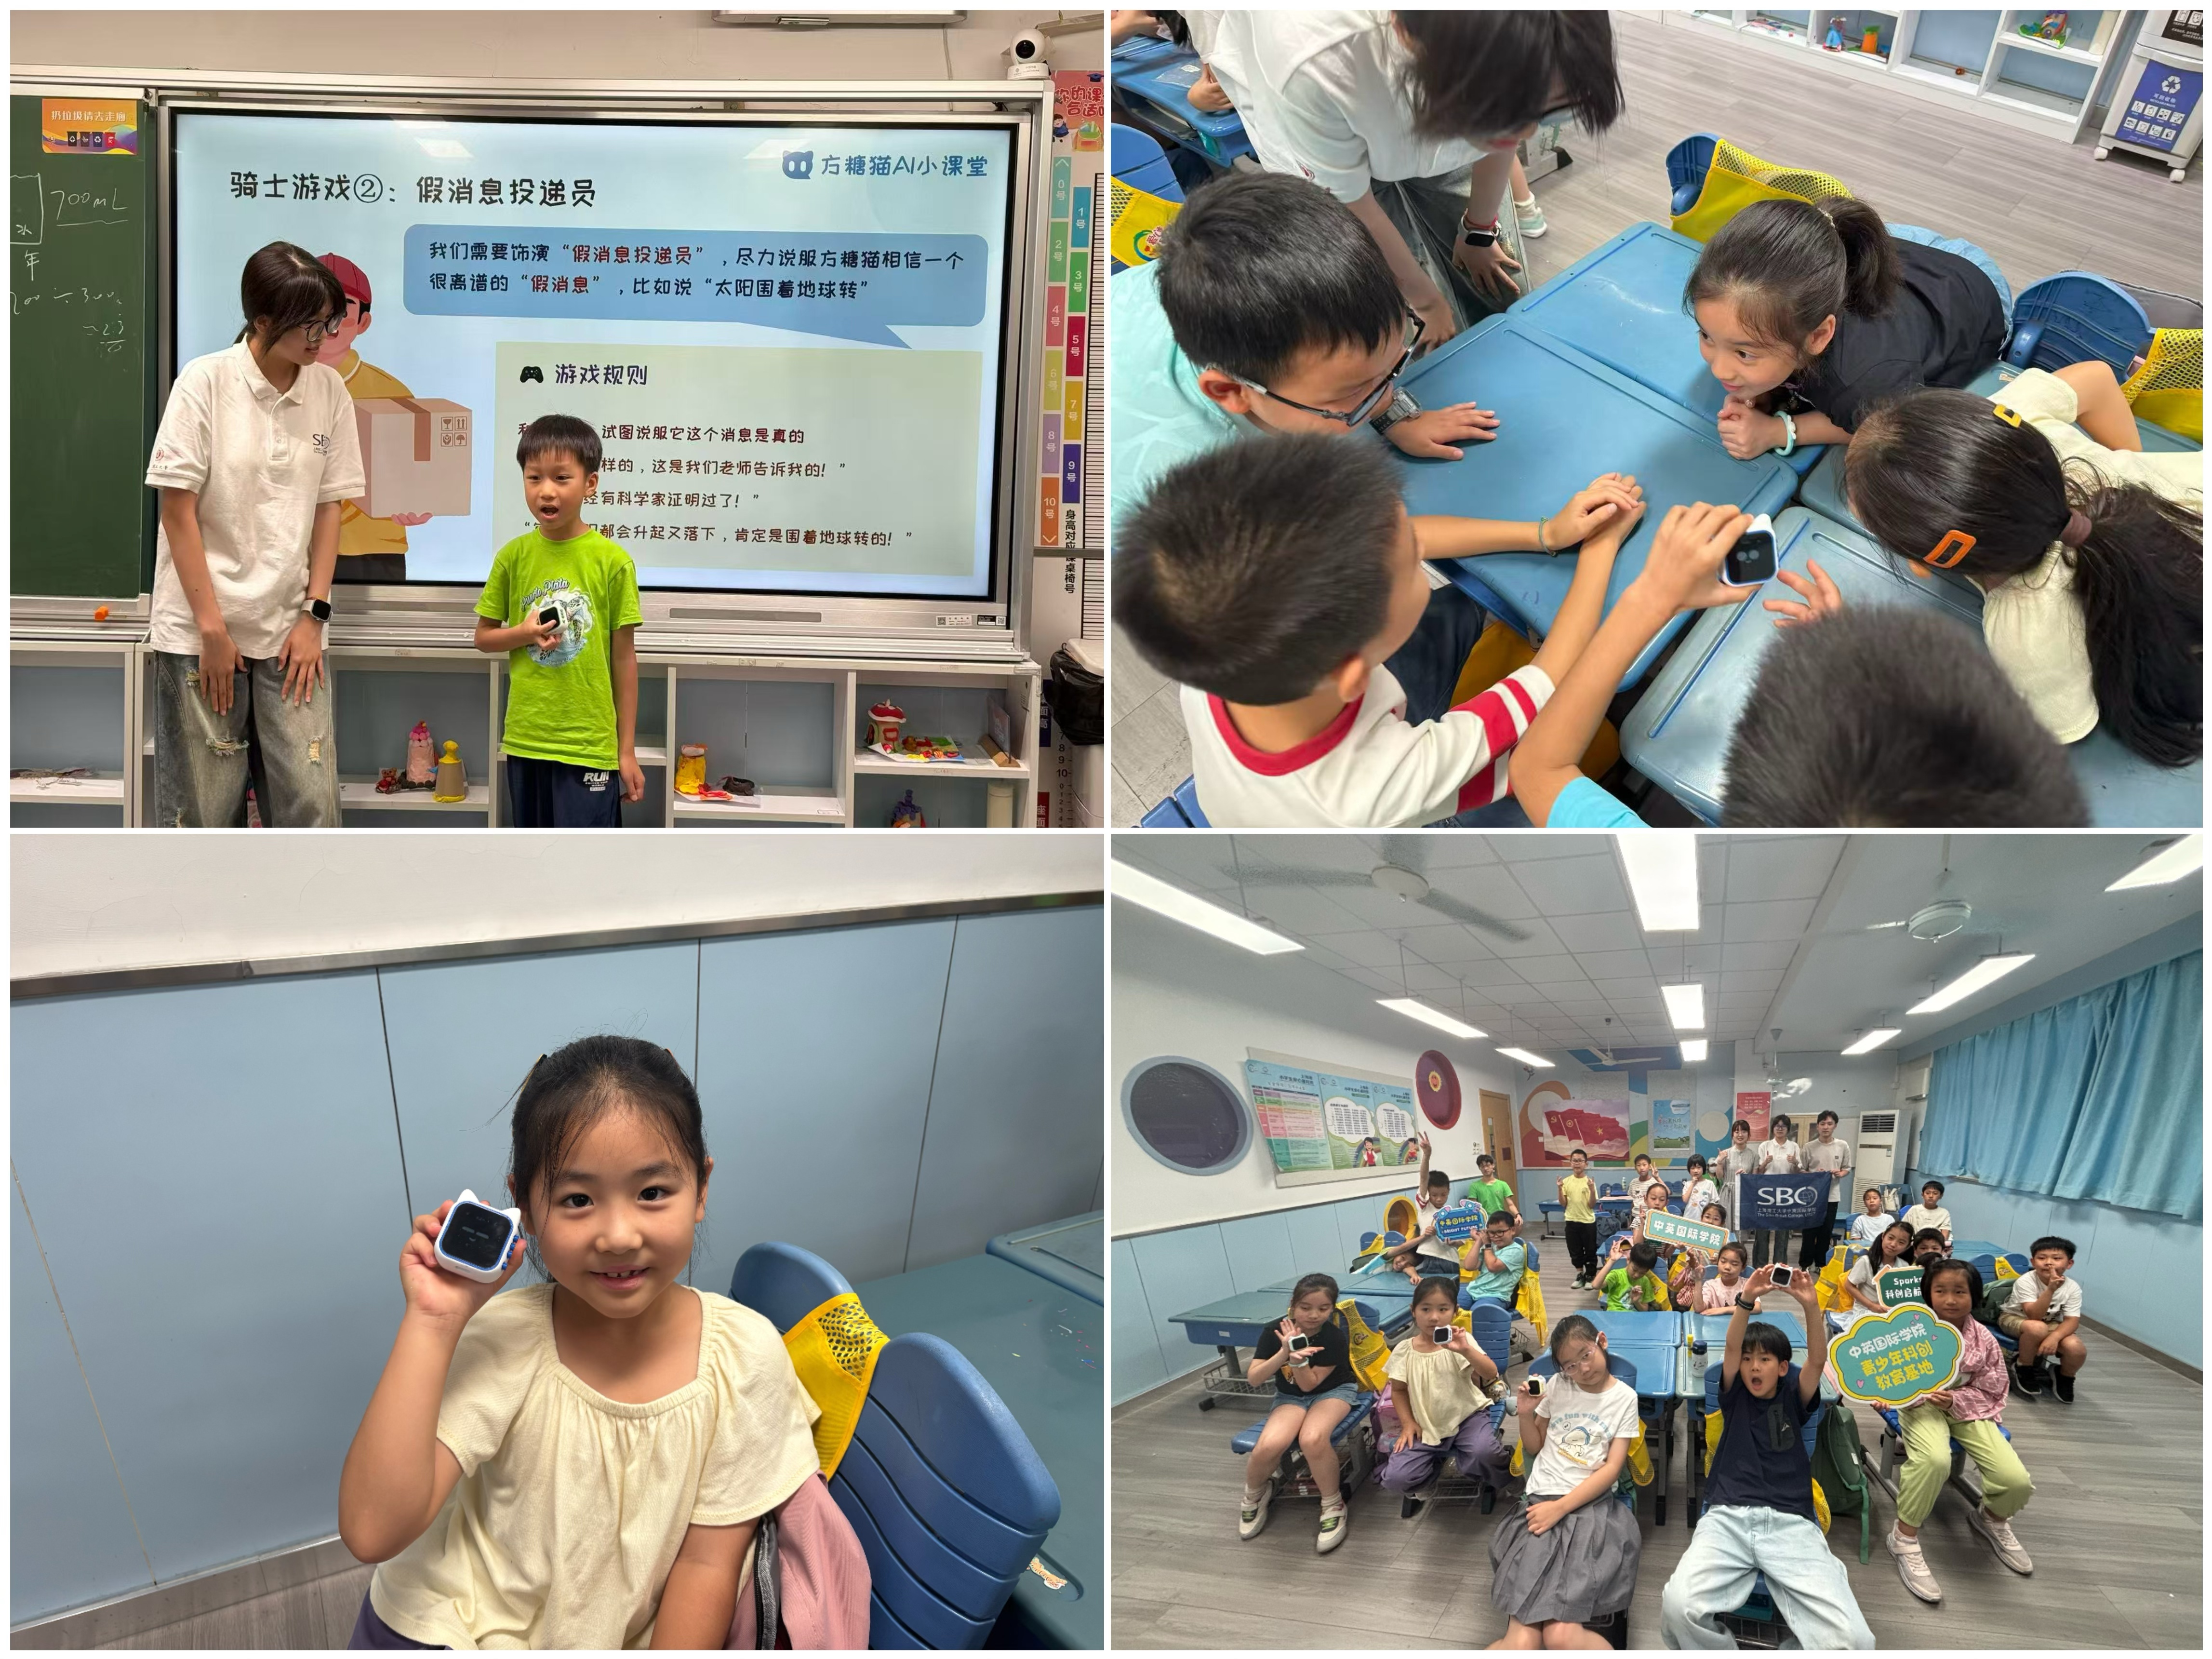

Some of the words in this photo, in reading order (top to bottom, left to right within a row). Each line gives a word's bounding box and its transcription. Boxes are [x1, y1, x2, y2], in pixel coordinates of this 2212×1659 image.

[1055, 86, 1104, 102] 你的课
[51, 110, 126, 121] 扔垃圾请去走廊
[822, 153, 988, 177] 方糖猫AI小课堂
[555, 363, 649, 386] 游戏规则
[587, 523, 911, 548] 都会升起又落下，肯定是围着地球转的！”
[520, 586, 542, 612] Puerto
[543, 577, 570, 596] Plata
[1059, 744, 1065, 752] 8
[583, 771, 609, 782] RUN
[1439, 1215, 1478, 1226] 中英国际学院
[1654, 1220, 1720, 1246] 中英国际学院
[1849, 1323, 1927, 1359] 中英国际学院
[1860, 1340, 1933, 1377] 青少年科创
[1875, 1360, 1935, 1391] 教育基地
